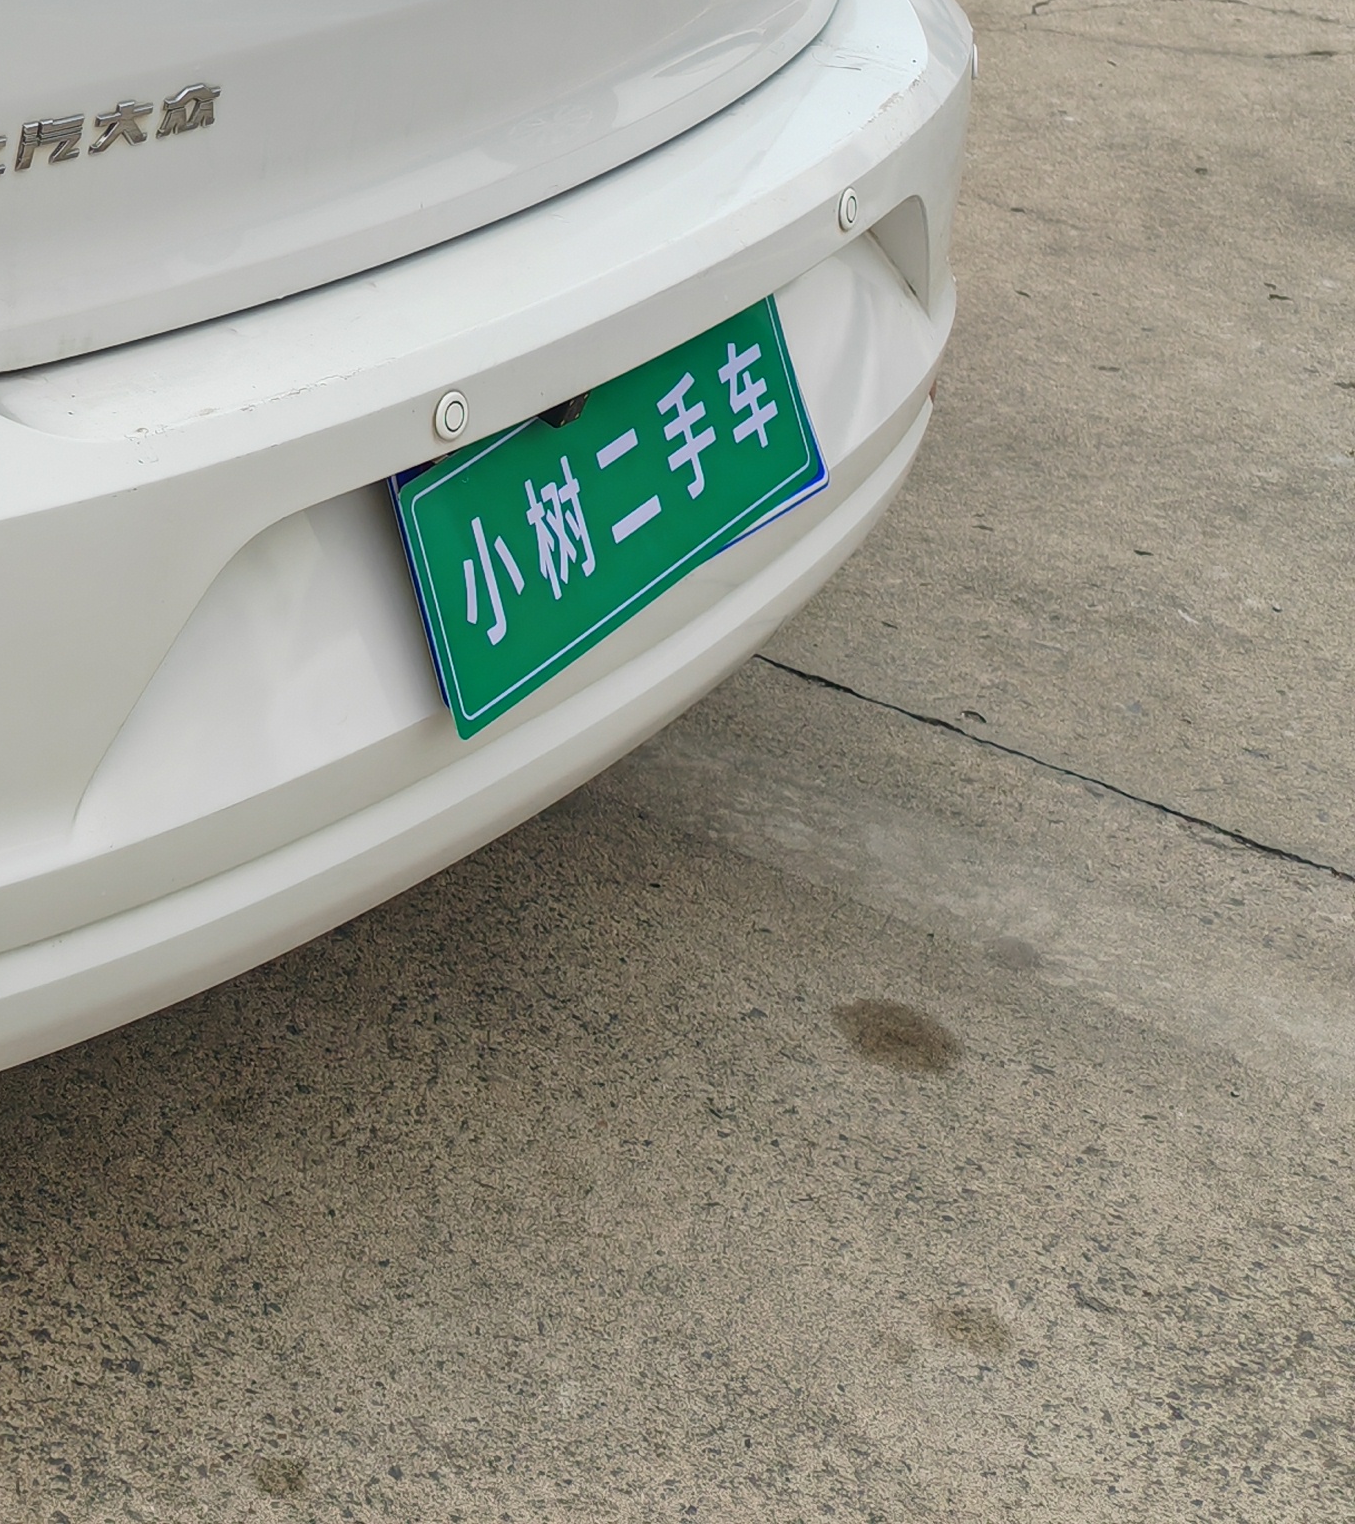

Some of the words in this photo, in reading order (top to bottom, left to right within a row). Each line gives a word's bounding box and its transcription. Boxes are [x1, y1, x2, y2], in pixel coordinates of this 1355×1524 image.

[462, 342, 779, 646] 小树二手车
